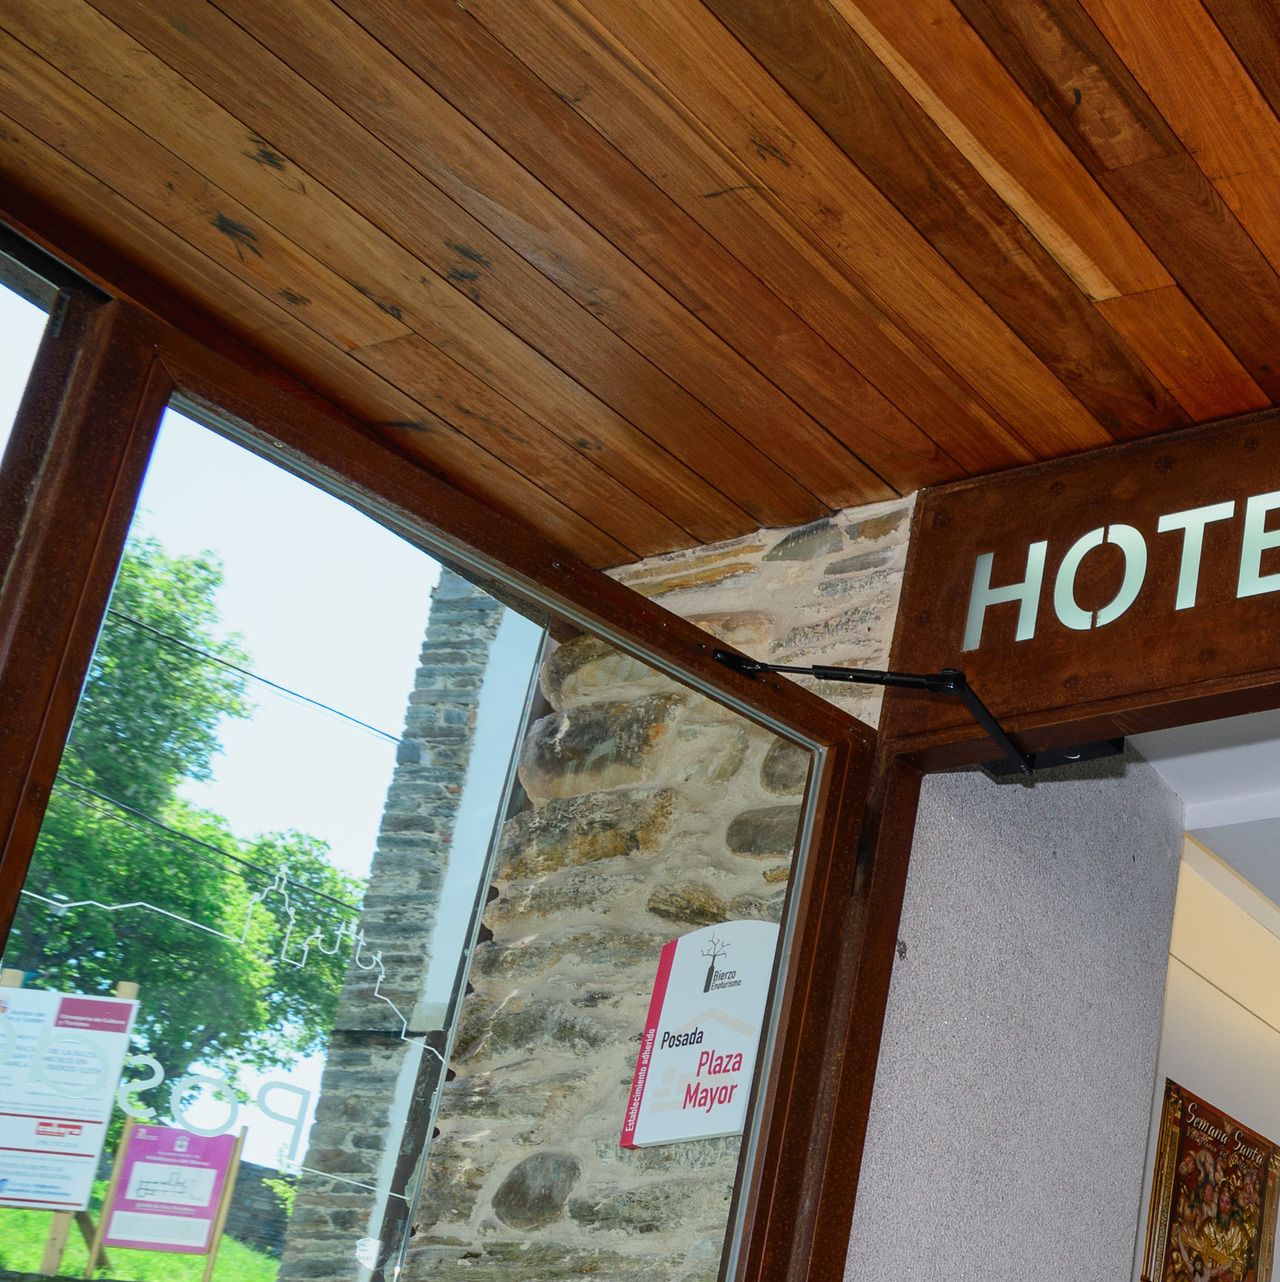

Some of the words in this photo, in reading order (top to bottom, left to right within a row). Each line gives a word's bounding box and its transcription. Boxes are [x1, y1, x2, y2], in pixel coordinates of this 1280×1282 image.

[711, 979, 742, 991] Enoturismo
[713, 969, 737, 982] Bierzo
[660, 1027, 704, 1050] Posada
[696, 1050, 743, 1077] Plaza
[625, 1067, 647, 1132] Establecimiento
[642, 1028, 655, 1065] adherido
[682, 1082, 738, 1113] Mayor
[1186, 1102, 1228, 1145] Semana
[1232, 1130, 1264, 1165] Santa
